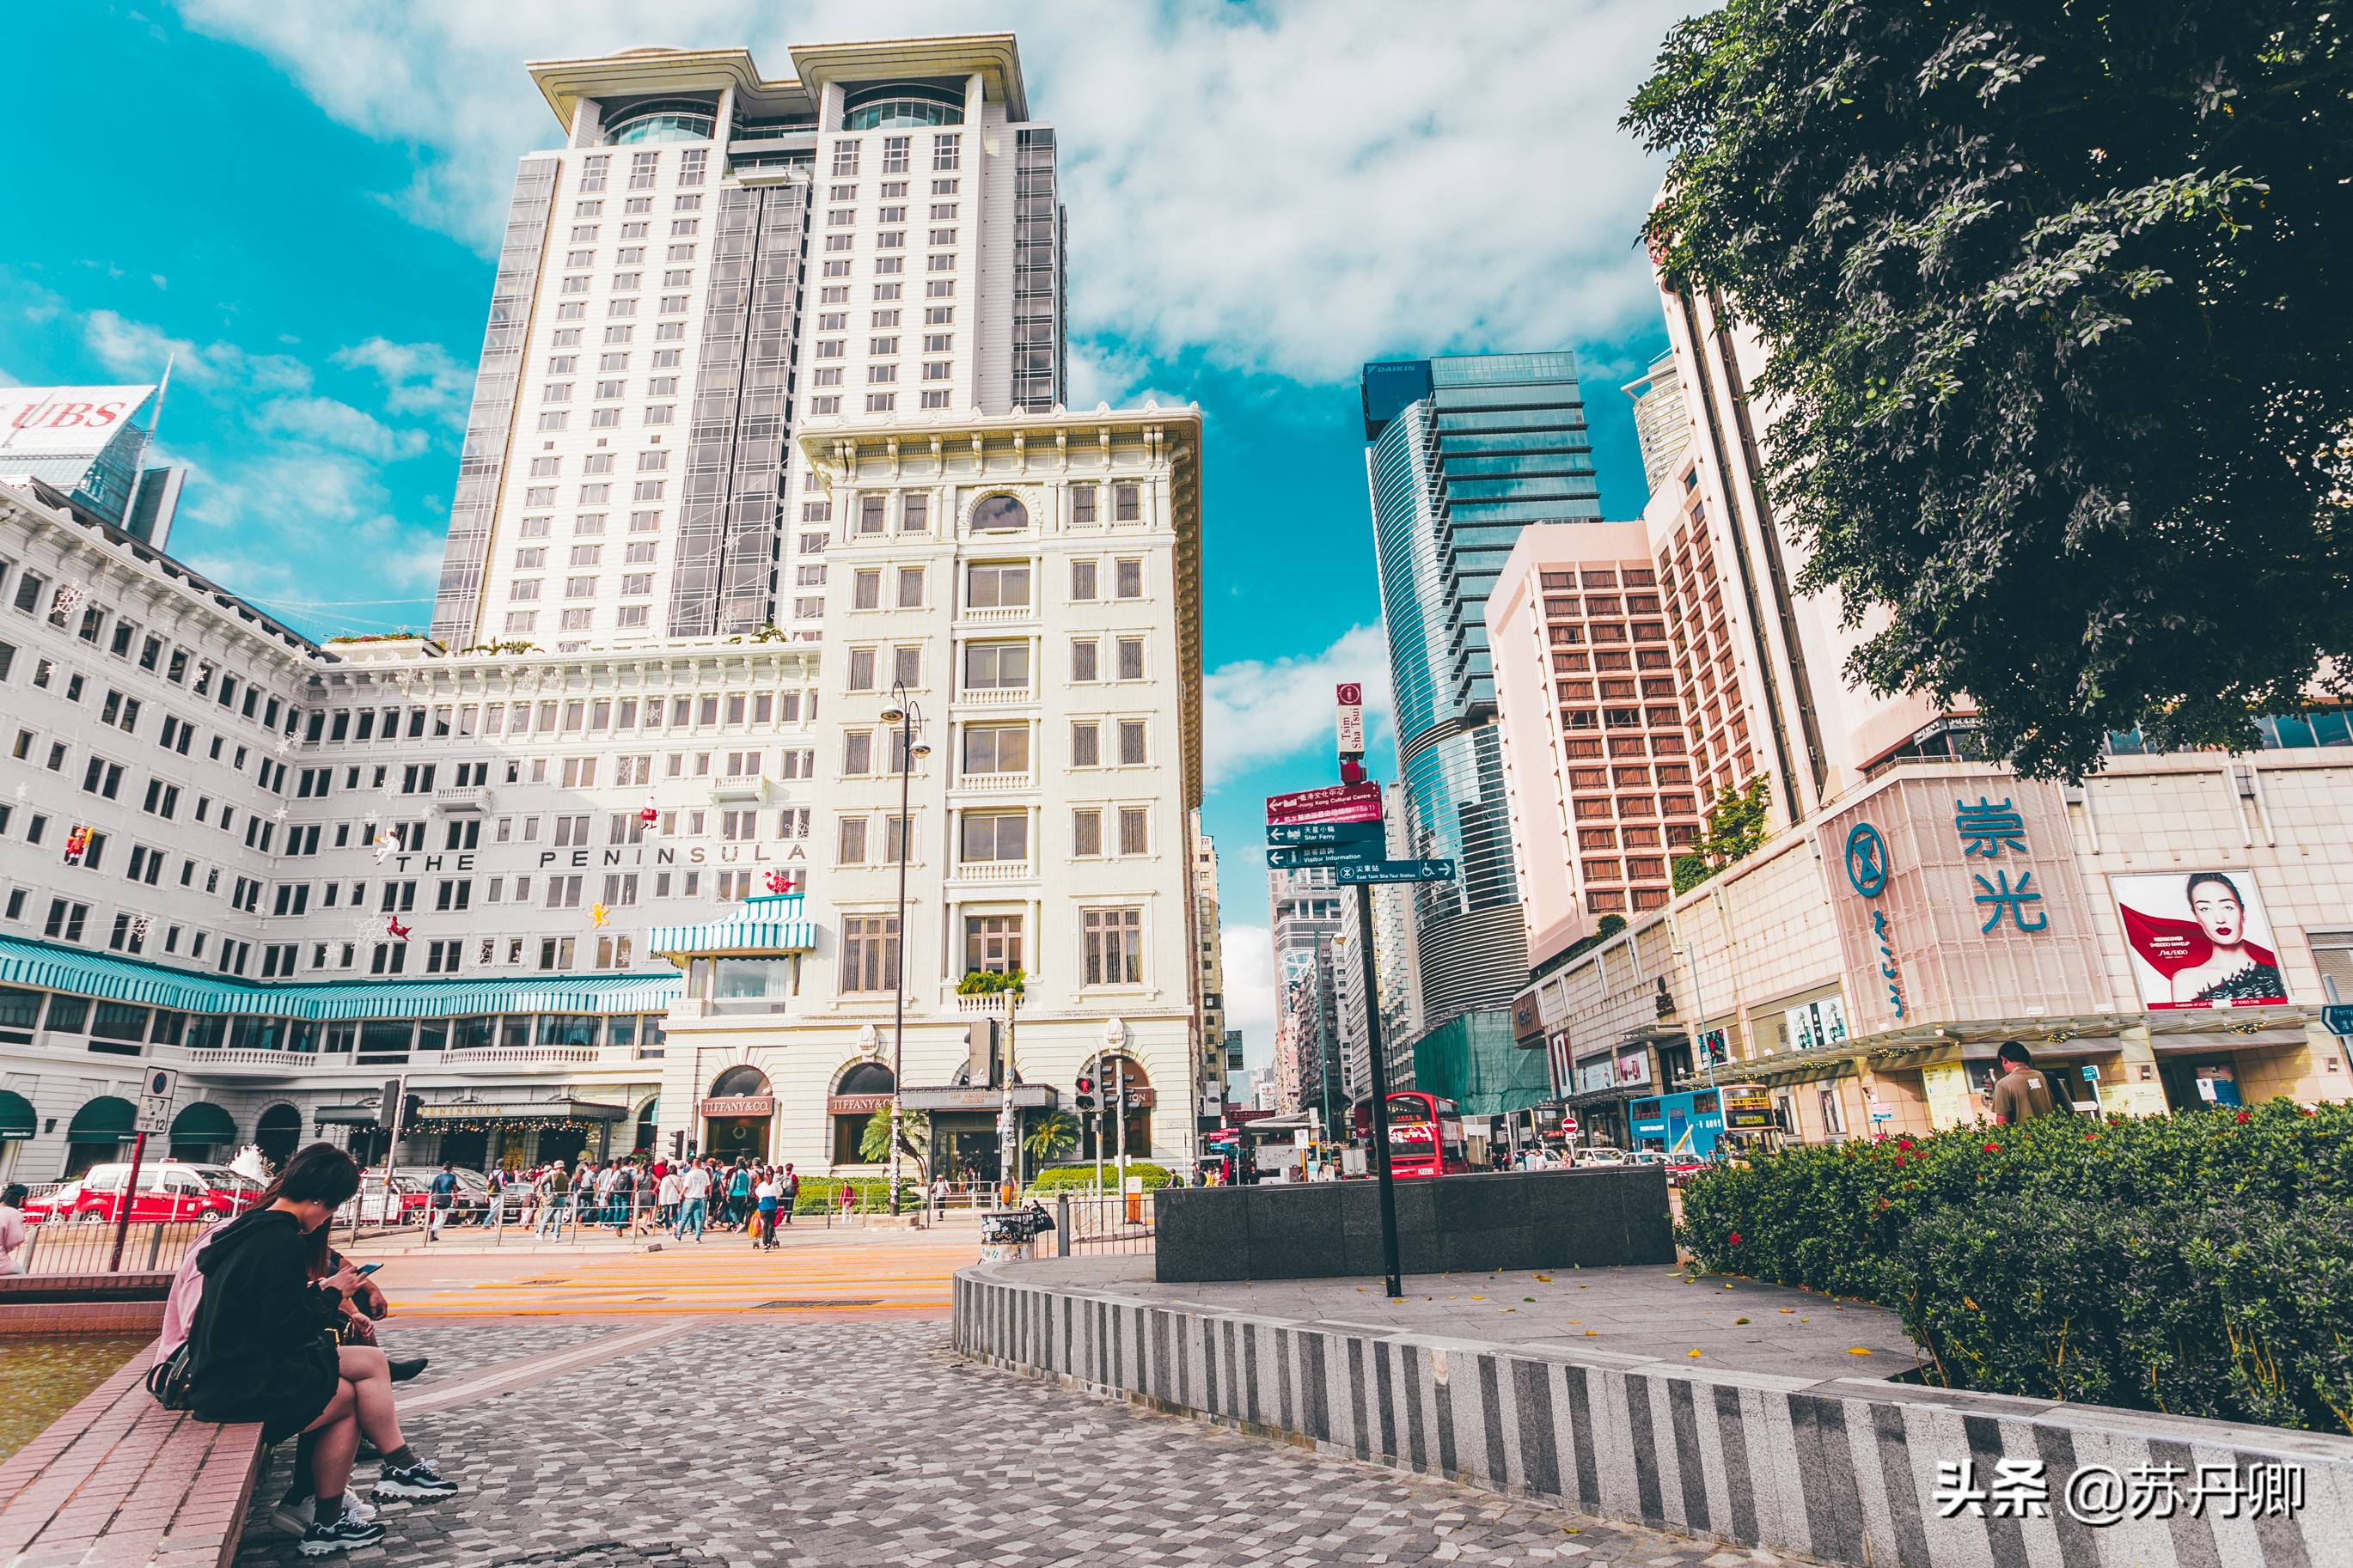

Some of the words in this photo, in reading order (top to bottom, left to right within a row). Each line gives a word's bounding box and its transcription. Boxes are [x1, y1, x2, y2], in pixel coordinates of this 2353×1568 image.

[11, 401, 126, 429] UBS
[1350, 708, 1360, 728] Tsui
[1341, 717, 1351, 741] Tsim
[1351, 731, 1361, 749] Sha
[396, 854, 475, 873] THE
[540, 844, 807, 868] PENINSULA
[1955, 796, 2048, 934] 崇光
[159, 1101, 165, 1111] 7
[420, 1106, 502, 1116] PENINSULA
[156, 1120, 165, 1130] 12
